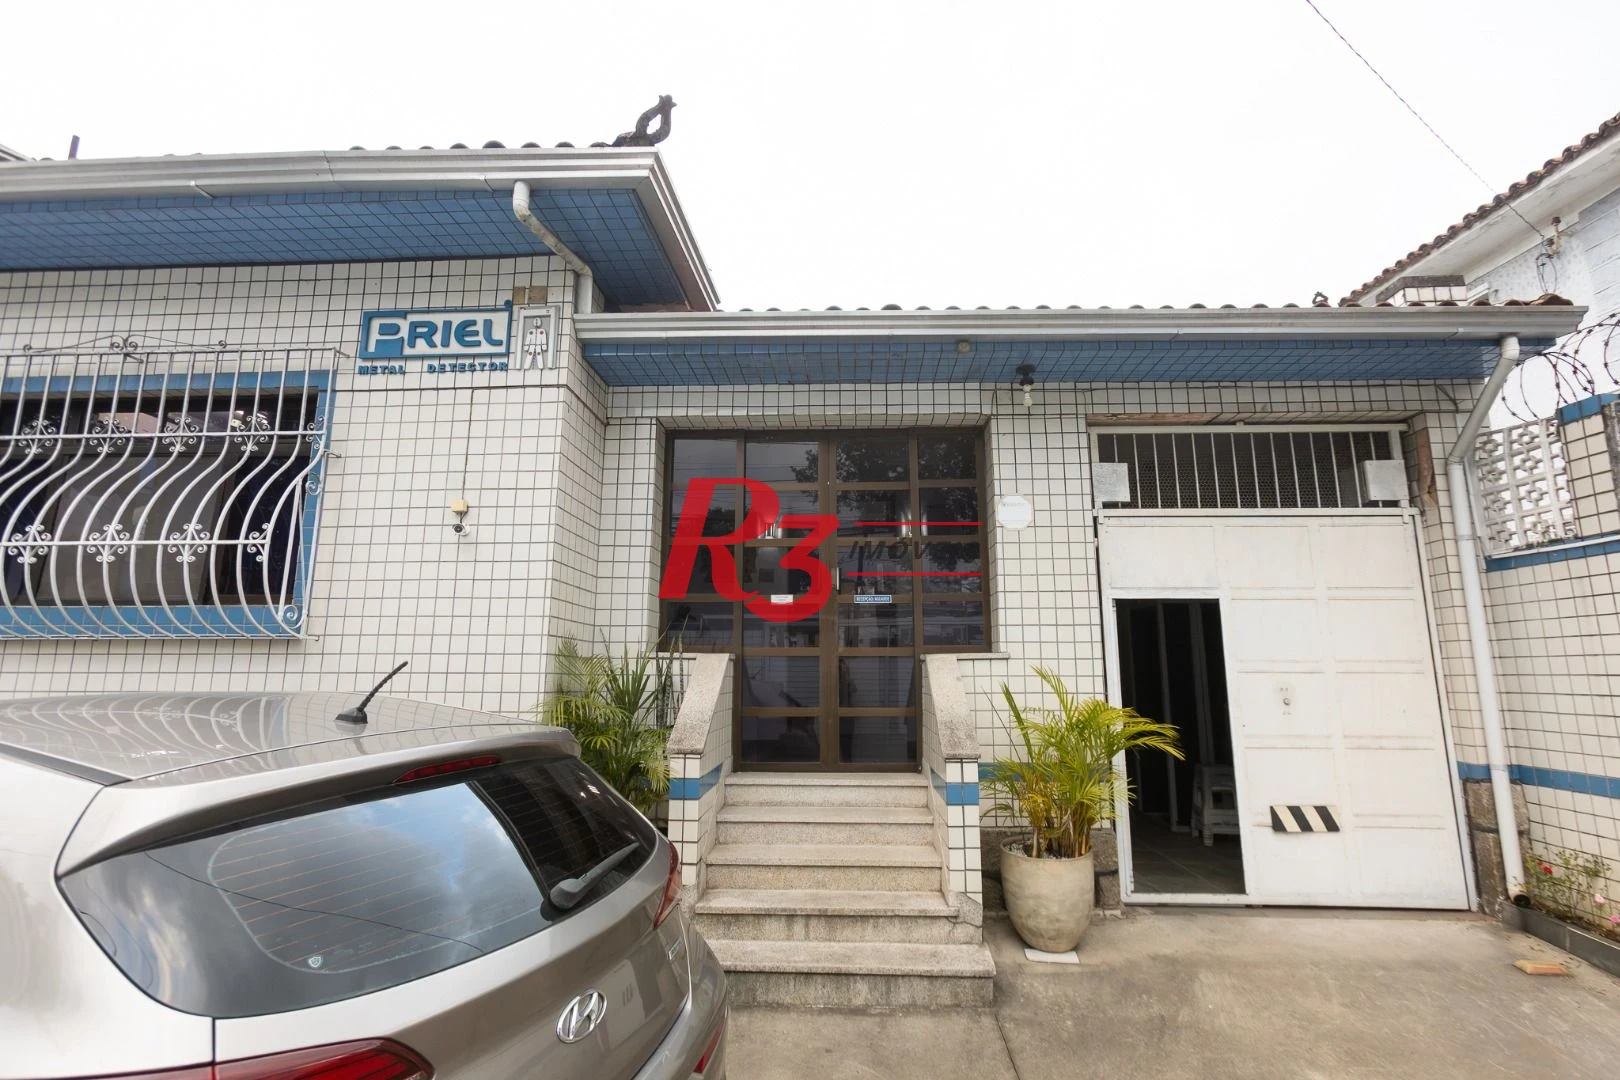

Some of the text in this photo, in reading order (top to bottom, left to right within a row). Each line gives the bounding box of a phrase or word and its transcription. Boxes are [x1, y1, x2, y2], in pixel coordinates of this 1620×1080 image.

[365, 315, 504, 353] PRIEL
[358, 361, 509, 375] METAL DETECTOR
